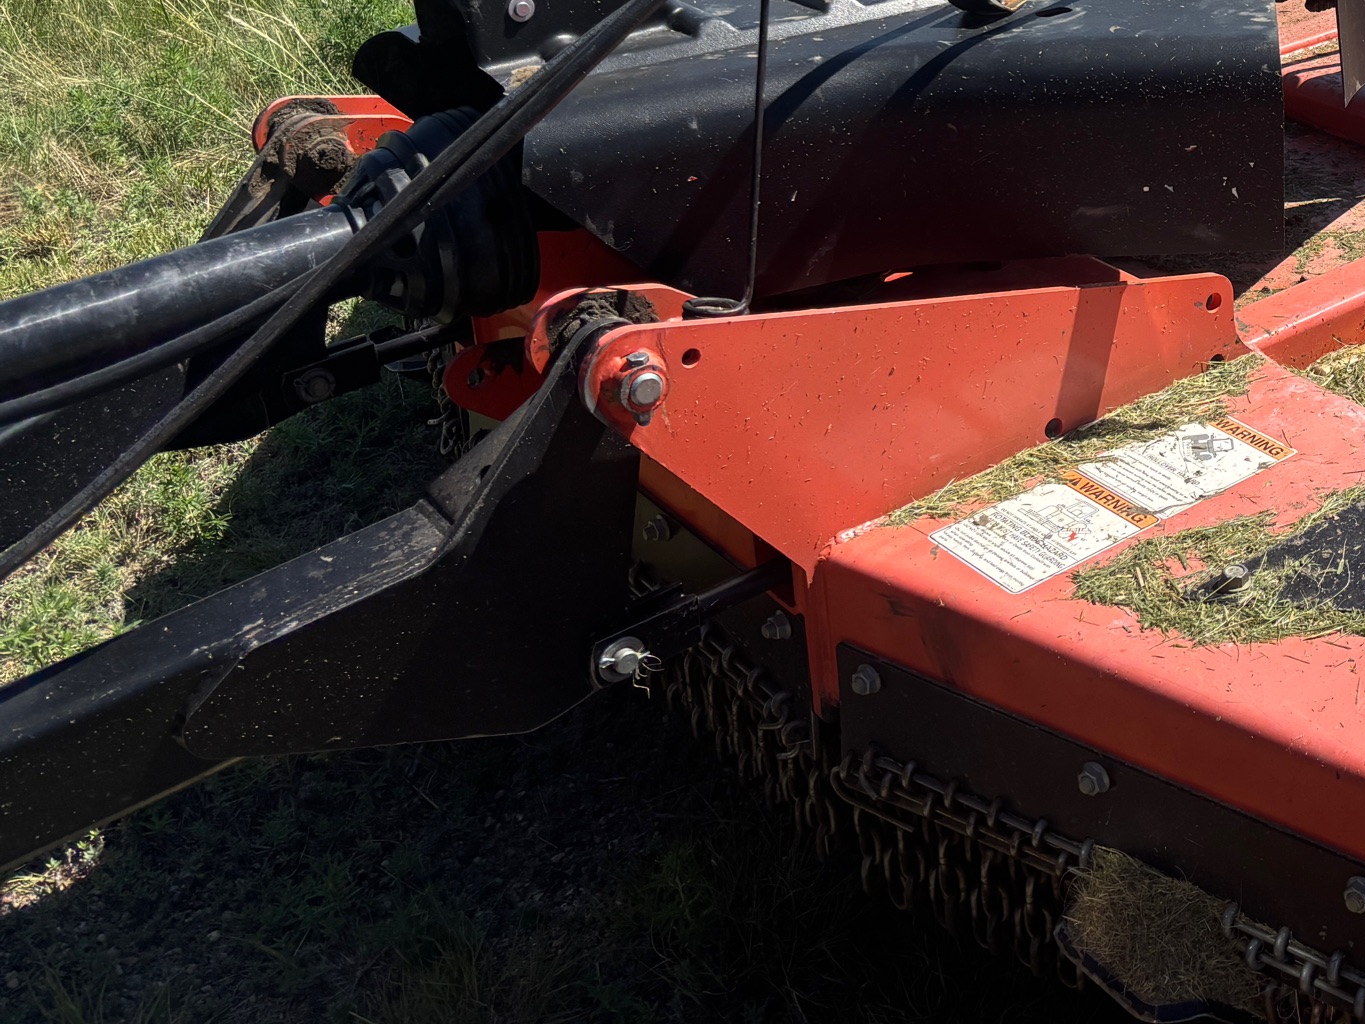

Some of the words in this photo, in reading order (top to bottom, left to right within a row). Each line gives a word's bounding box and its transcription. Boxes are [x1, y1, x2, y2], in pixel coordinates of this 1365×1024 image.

[1213, 418, 1285, 457] WARNING
[1078, 483, 1147, 525] WARNING
[991, 511, 1022, 532] ROTATING
[1020, 540, 1041, 553] SAFETY
[1038, 551, 1066, 569] GUARDING
